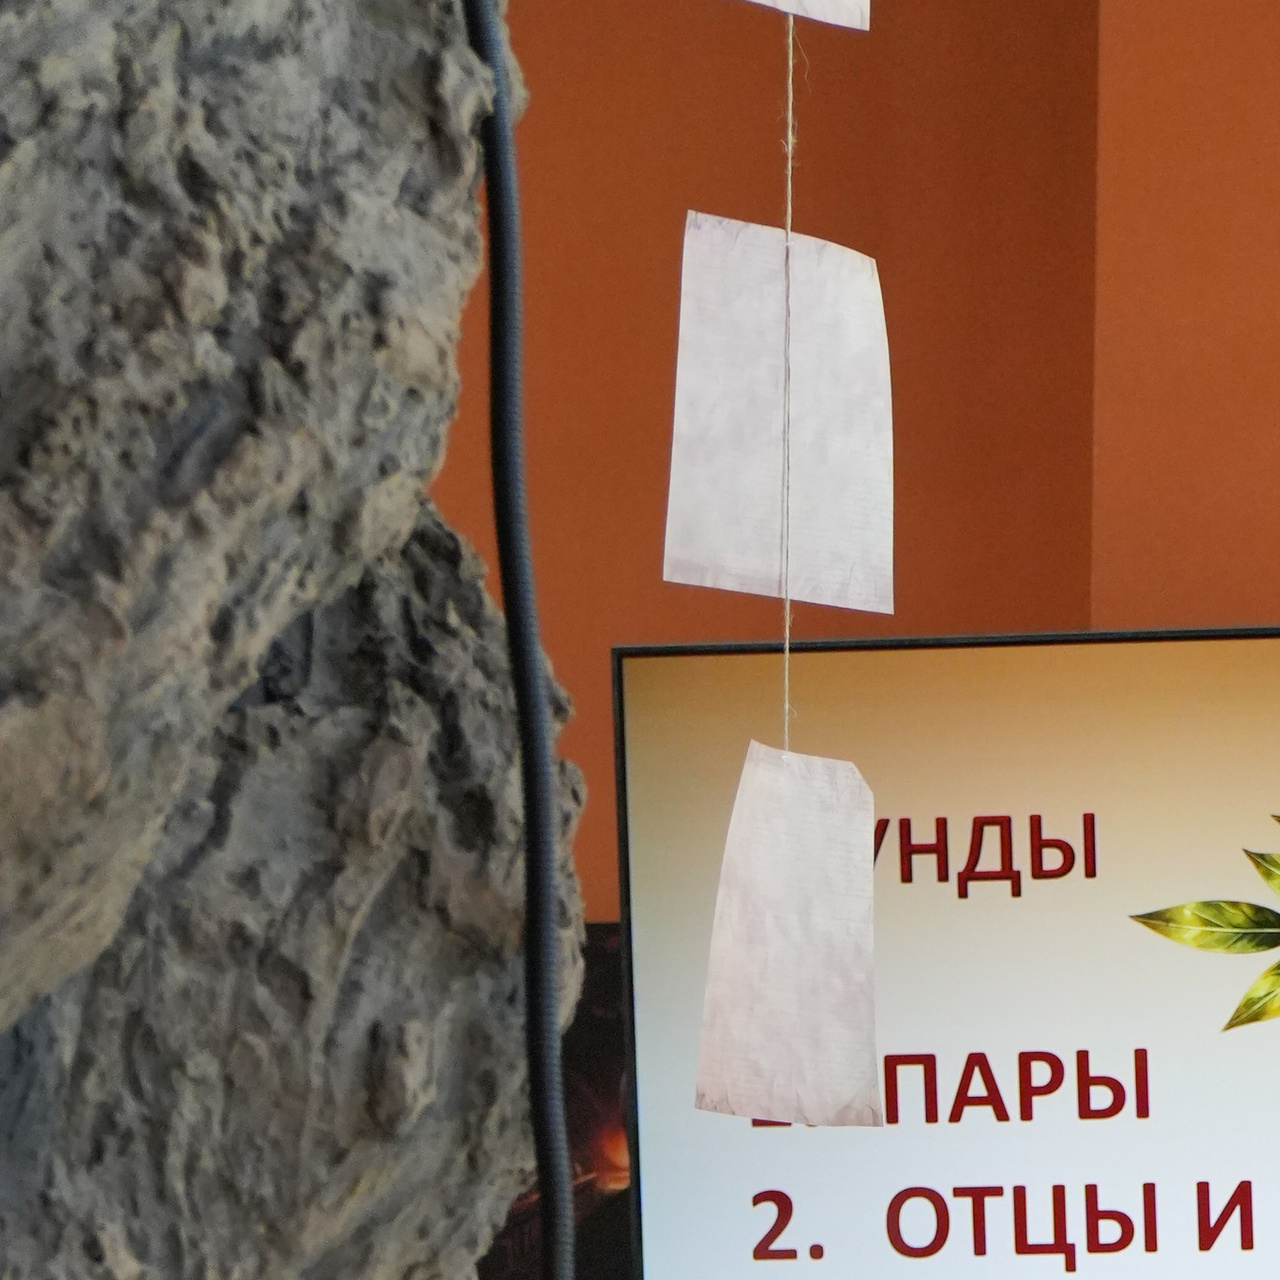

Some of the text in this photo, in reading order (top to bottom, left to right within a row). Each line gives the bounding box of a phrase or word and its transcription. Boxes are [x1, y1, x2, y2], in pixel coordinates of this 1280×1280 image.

[884, 1048, 1150, 1125] ПАРЫ
[753, 1190, 823, 1260] 2.
[886, 1182, 1158, 1272] ОТЦЫ
[1196, 1180, 1254, 1251] И
